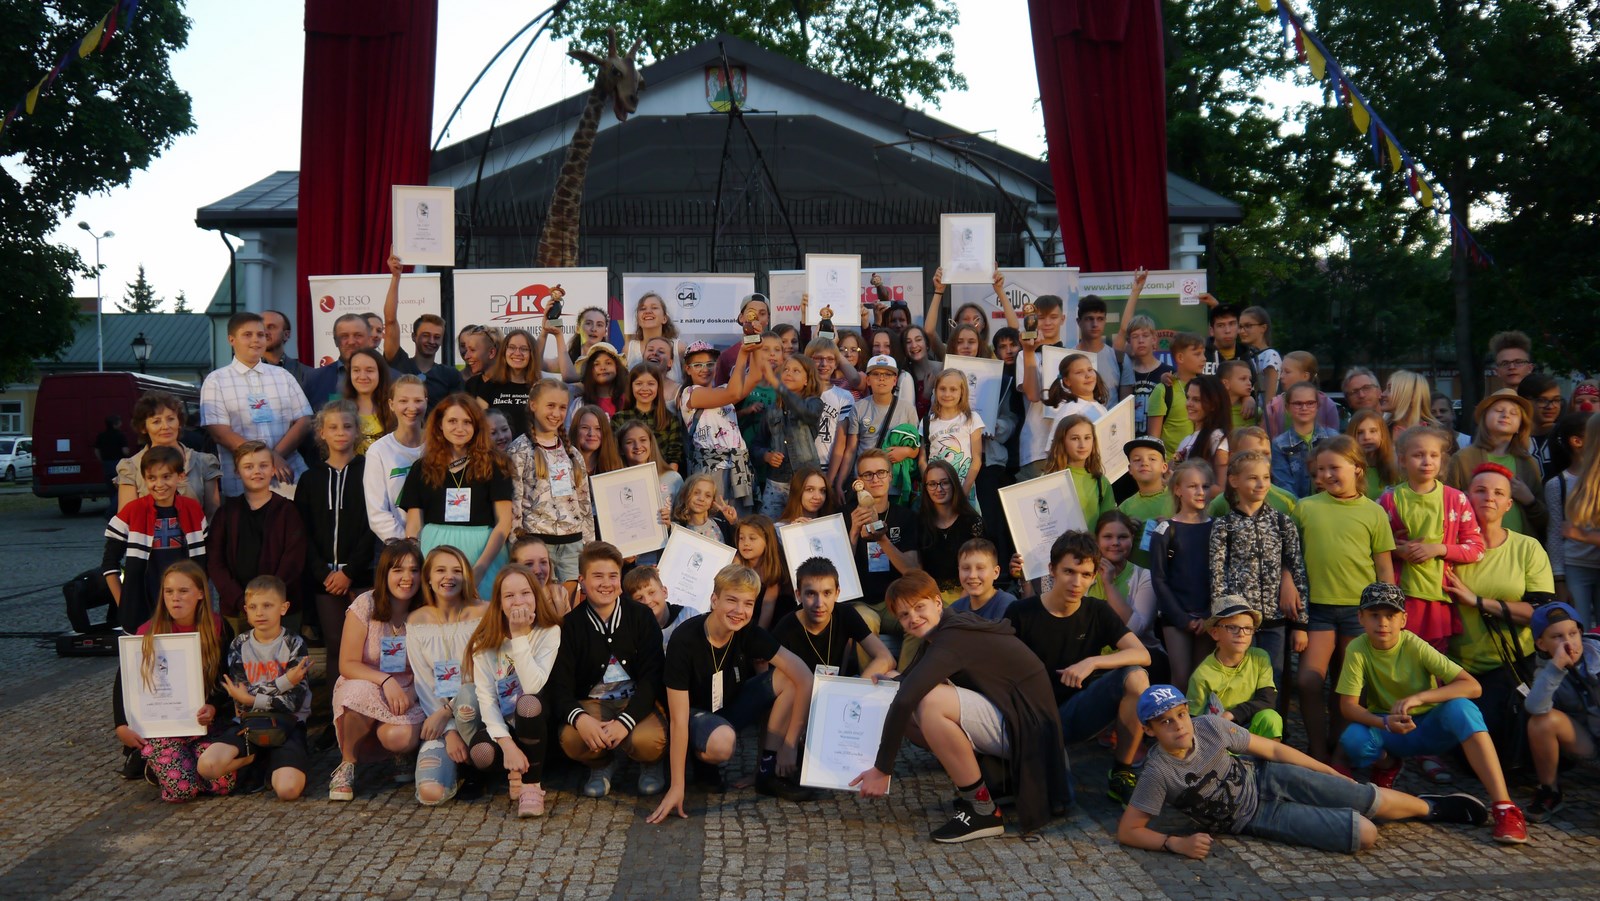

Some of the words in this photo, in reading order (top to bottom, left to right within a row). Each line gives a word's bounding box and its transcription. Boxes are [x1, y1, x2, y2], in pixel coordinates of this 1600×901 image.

[1083, 281, 1175, 292] www.krusz.com.pl
[338, 295, 371, 306] RESO
[677, 292, 698, 301] CAL
[1149, 688, 1177, 703] NY
